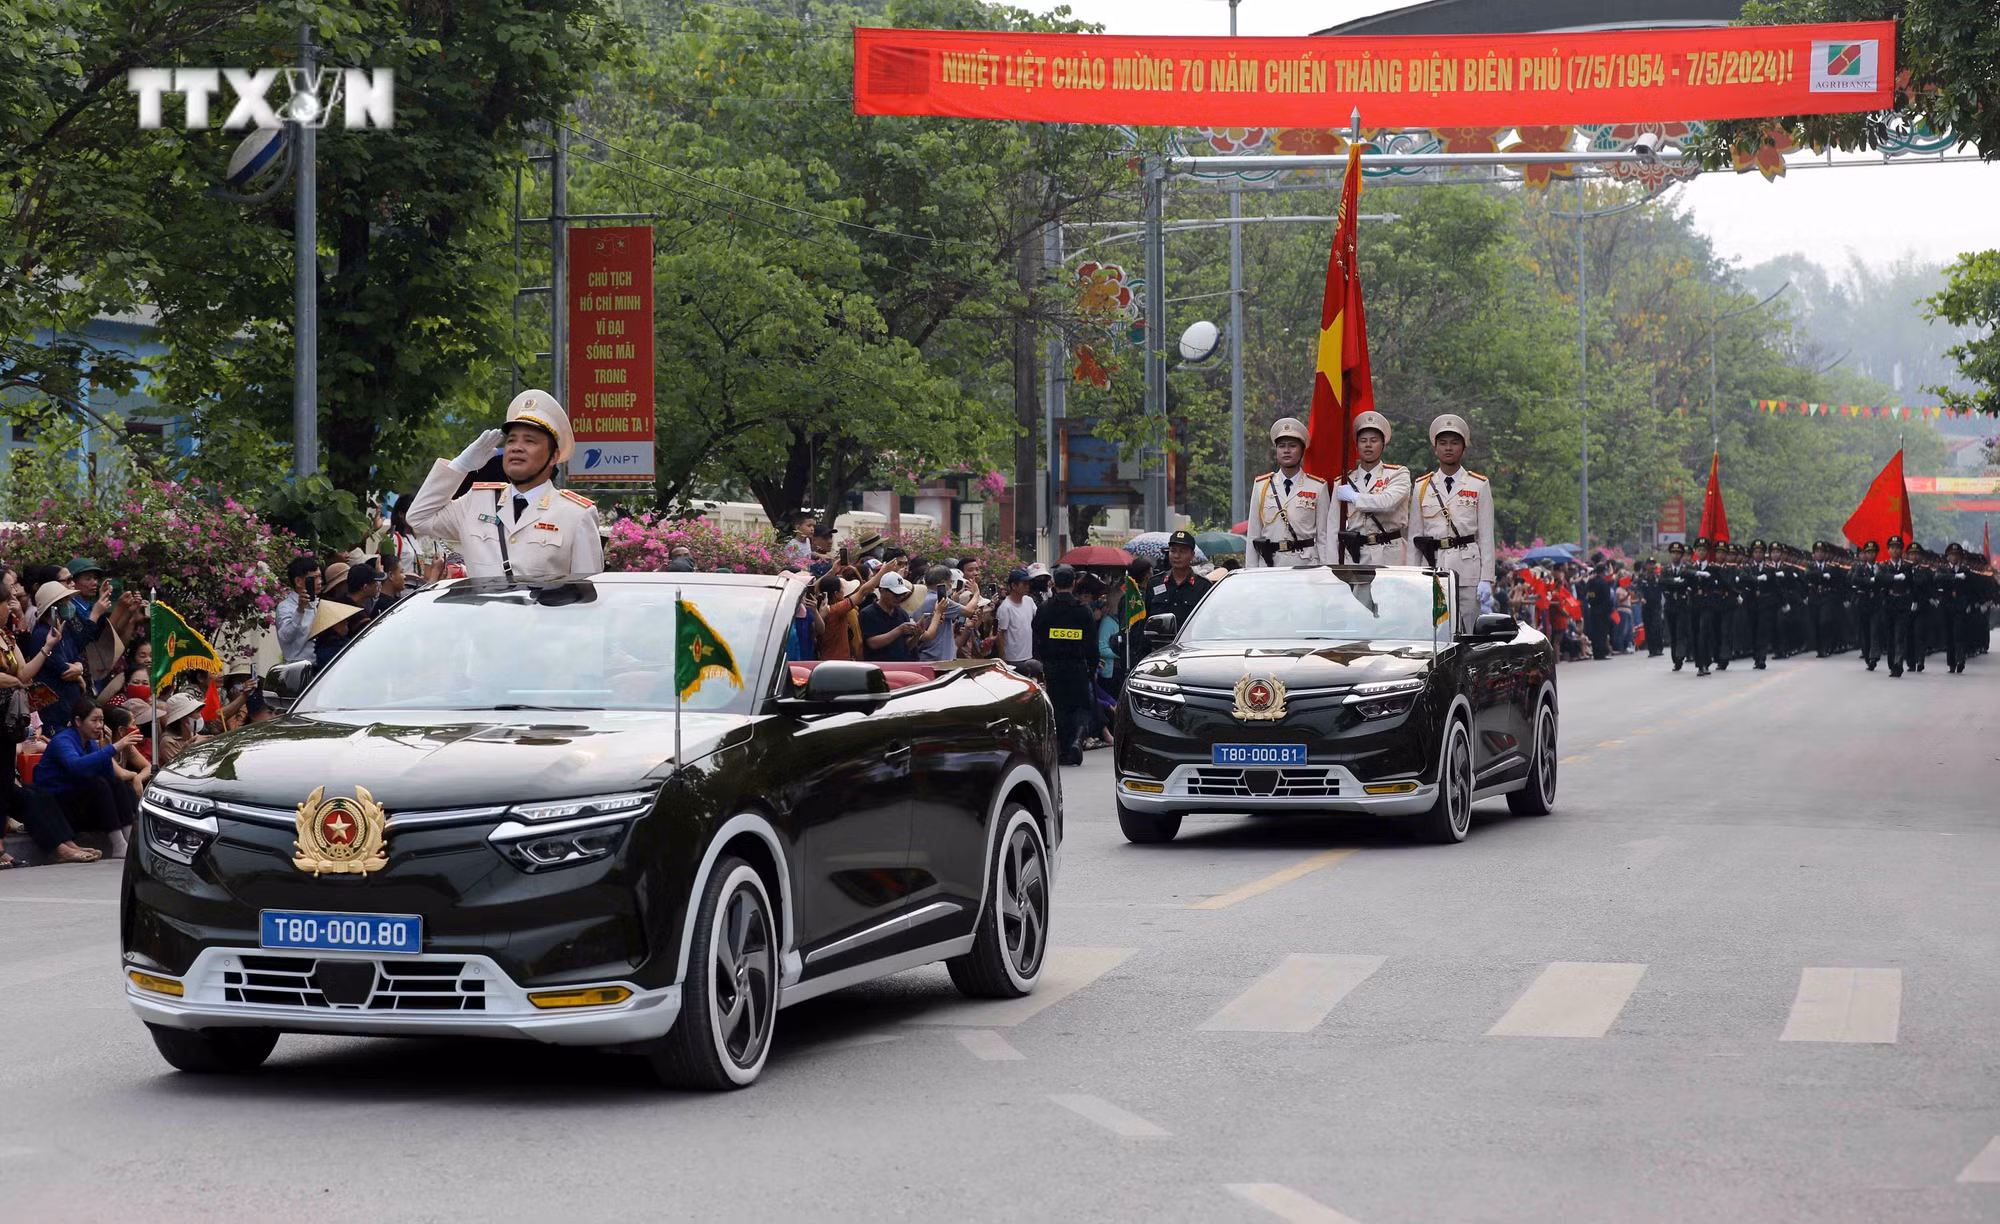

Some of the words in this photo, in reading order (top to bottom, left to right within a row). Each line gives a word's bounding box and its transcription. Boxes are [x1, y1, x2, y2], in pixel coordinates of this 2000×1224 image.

[942, 48, 1000, 91] NHIỆT
[1005, 49, 1046, 93] LIỆT
[1052, 51, 1105, 90] CHÀO
[1112, 51, 1174, 92] MỪNG
[1180, 59, 1205, 92] 70
[1210, 52, 1259, 93] NĂM
[1264, 51, 1327, 93] CHIẾN
[1334, 51, 1403, 93] THẮNG
[1408, 51, 1458, 98] ĐIỆN
[1463, 50, 1513, 92] BIÊN
[1519, 48, 1561, 91] PHỦ
[1566, 53, 1665, 93] (7/5/1954
[1686, 49, 1794, 86] 7/5/2024)!
[1815, 81, 1871, 89] AGRIBANK
[588, 266, 608, 288] CHỦ
[610, 271, 632, 290] TỊCH
[595, 292, 612, 311] CHÍ
[614, 295, 641, 311] MINH
[607, 319, 625, 338] ĐẠI
[586, 339, 613, 360] SỐNG
[615, 341, 635, 359] MÃI
[594, 368, 627, 384] TRONG
[584, 391, 599, 411] SỰ
[600, 389, 637, 411] NGHIỆP
[572, 412, 593, 433] CỦA
[595, 414, 629, 433] CHÚNG
[631, 417, 643, 432] TA
[604, 455, 639, 465] VNPT
[1221, 748, 1297, 762] T80-000.81
[274, 918, 407, 946] T80-000.80
